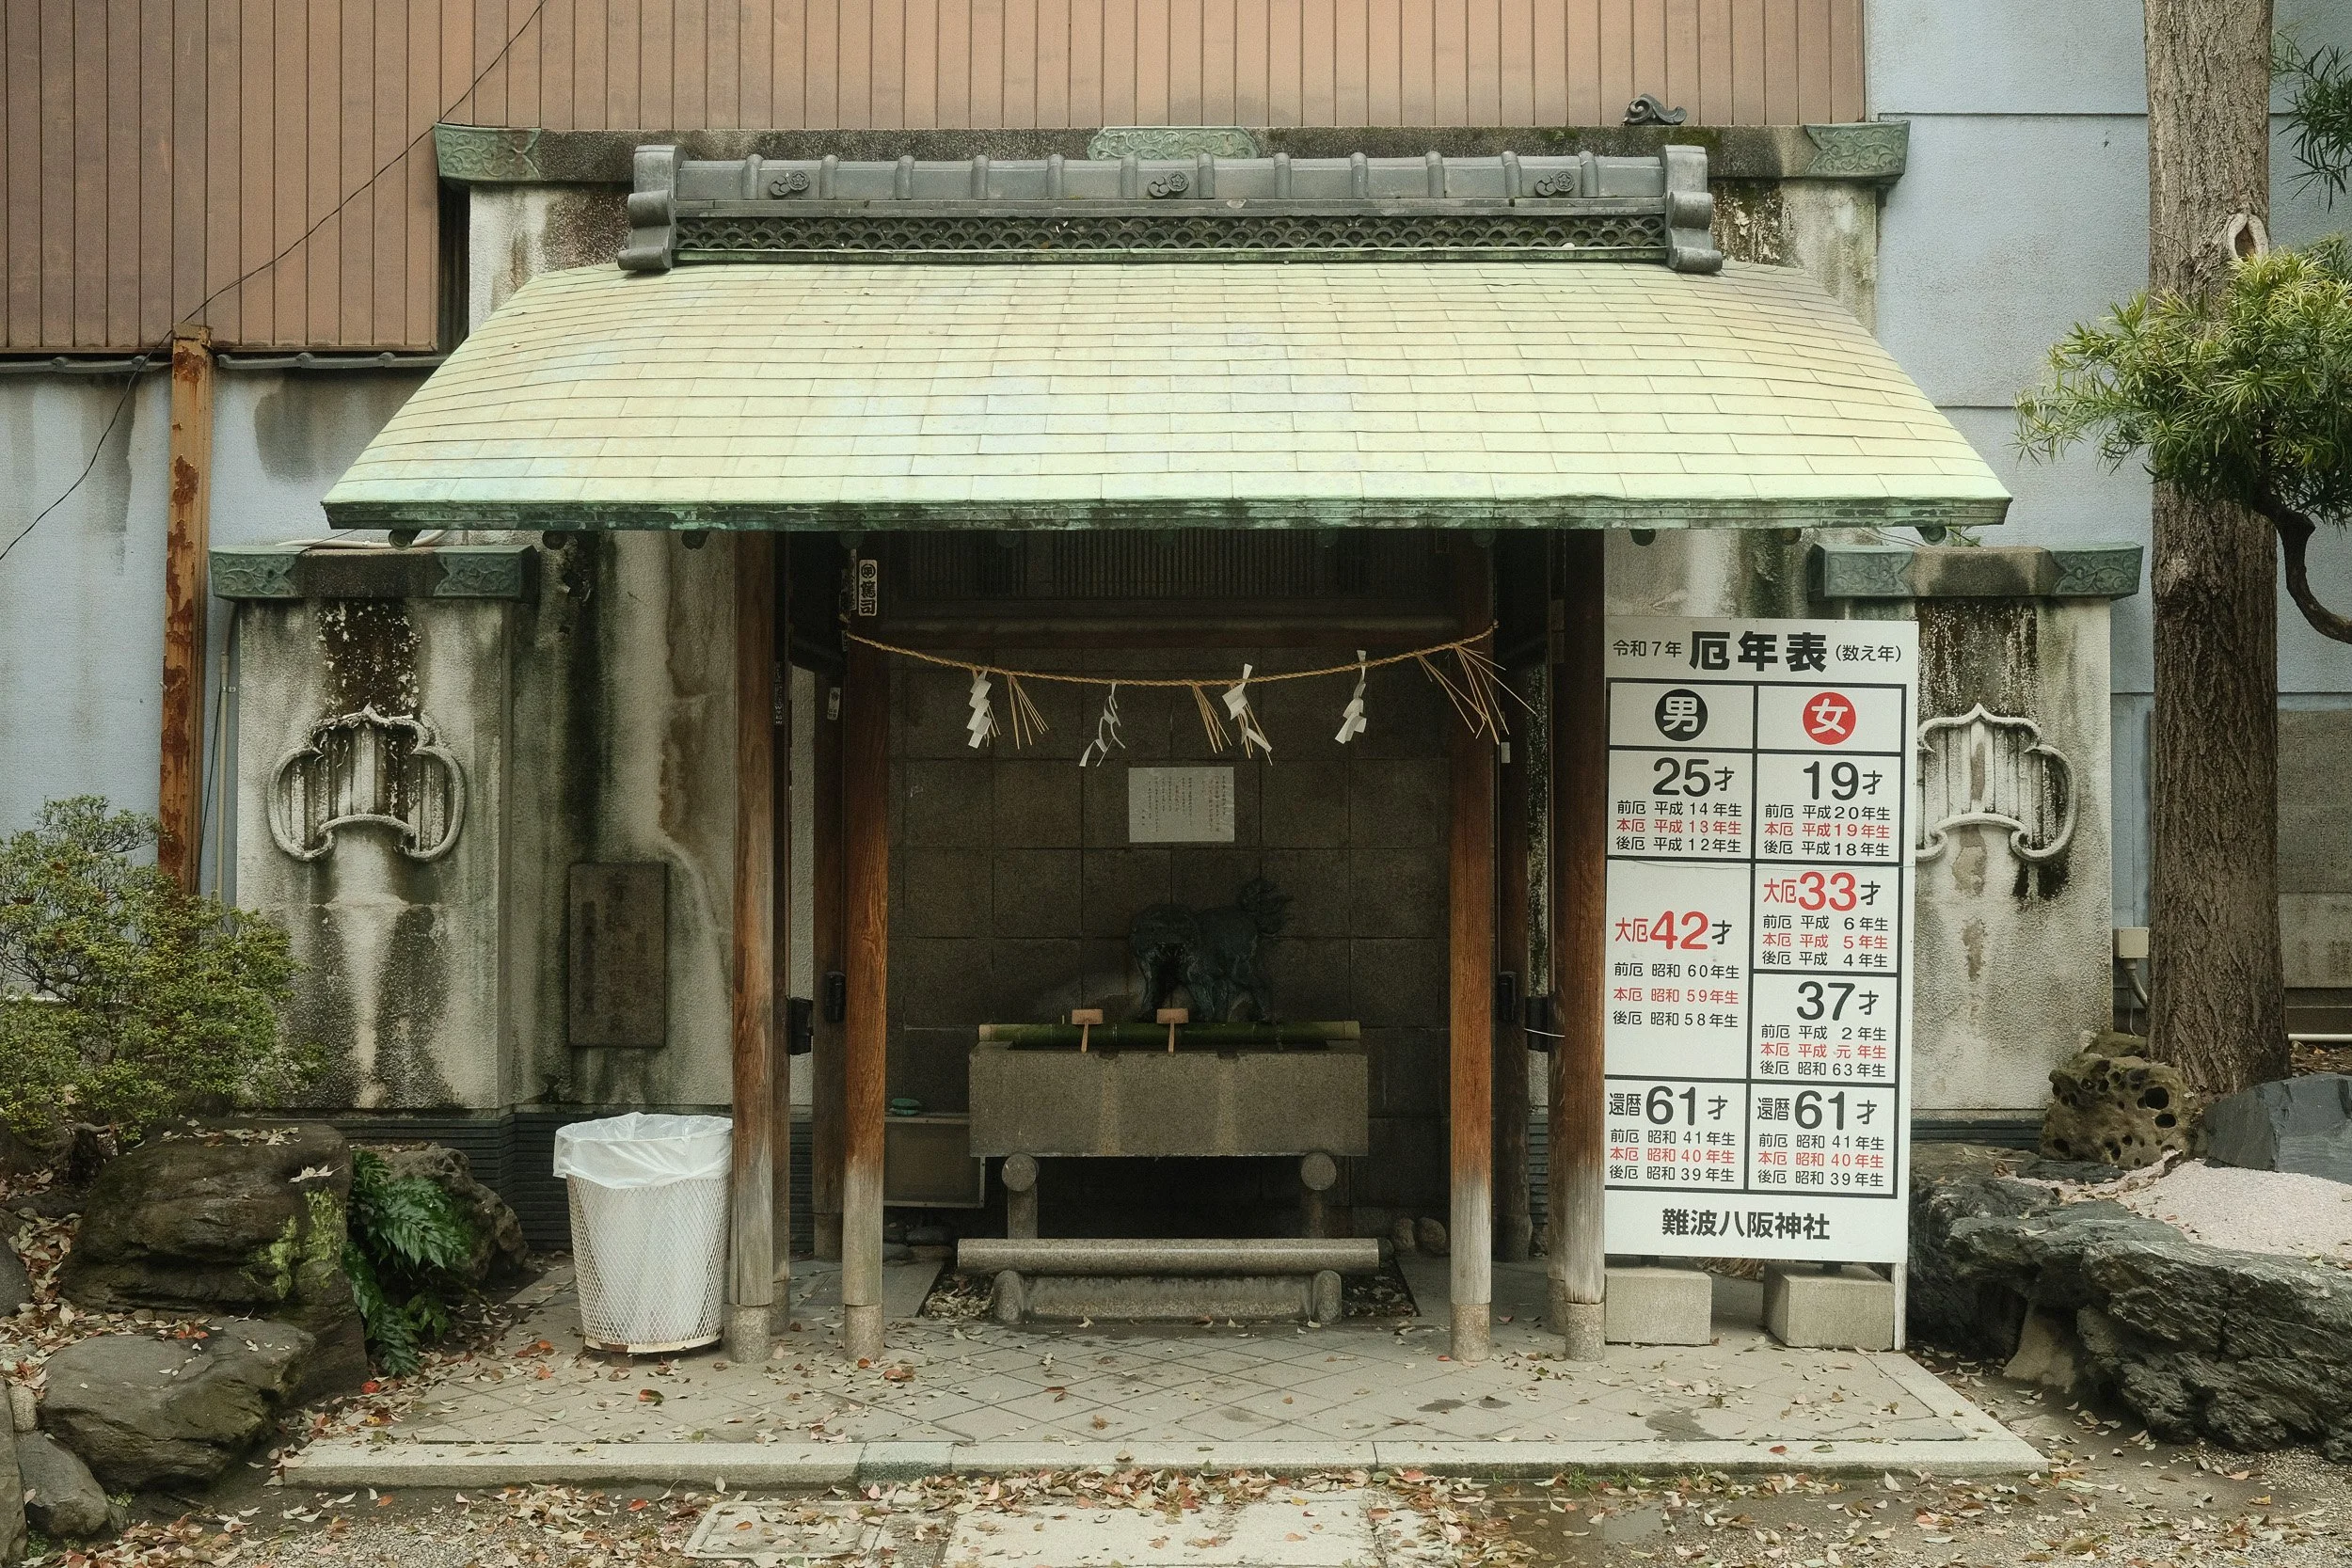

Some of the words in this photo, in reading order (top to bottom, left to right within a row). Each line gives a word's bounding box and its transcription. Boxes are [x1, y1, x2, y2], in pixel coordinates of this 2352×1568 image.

[1613, 640, 1682, 658] 令和7年
[1689, 630, 1827, 673] 厄年表
[1835, 645, 1902, 663] (数え年)
[1660, 693, 1703, 736] 男
[1807, 695, 1851, 739] 女
[1653, 757, 1735, 797] 25才
[1803, 760, 1883, 800] 19才
[1797, 981, 1879, 1021] 37才
[1661, 1208, 1830, 1240] 難波八阪神社
